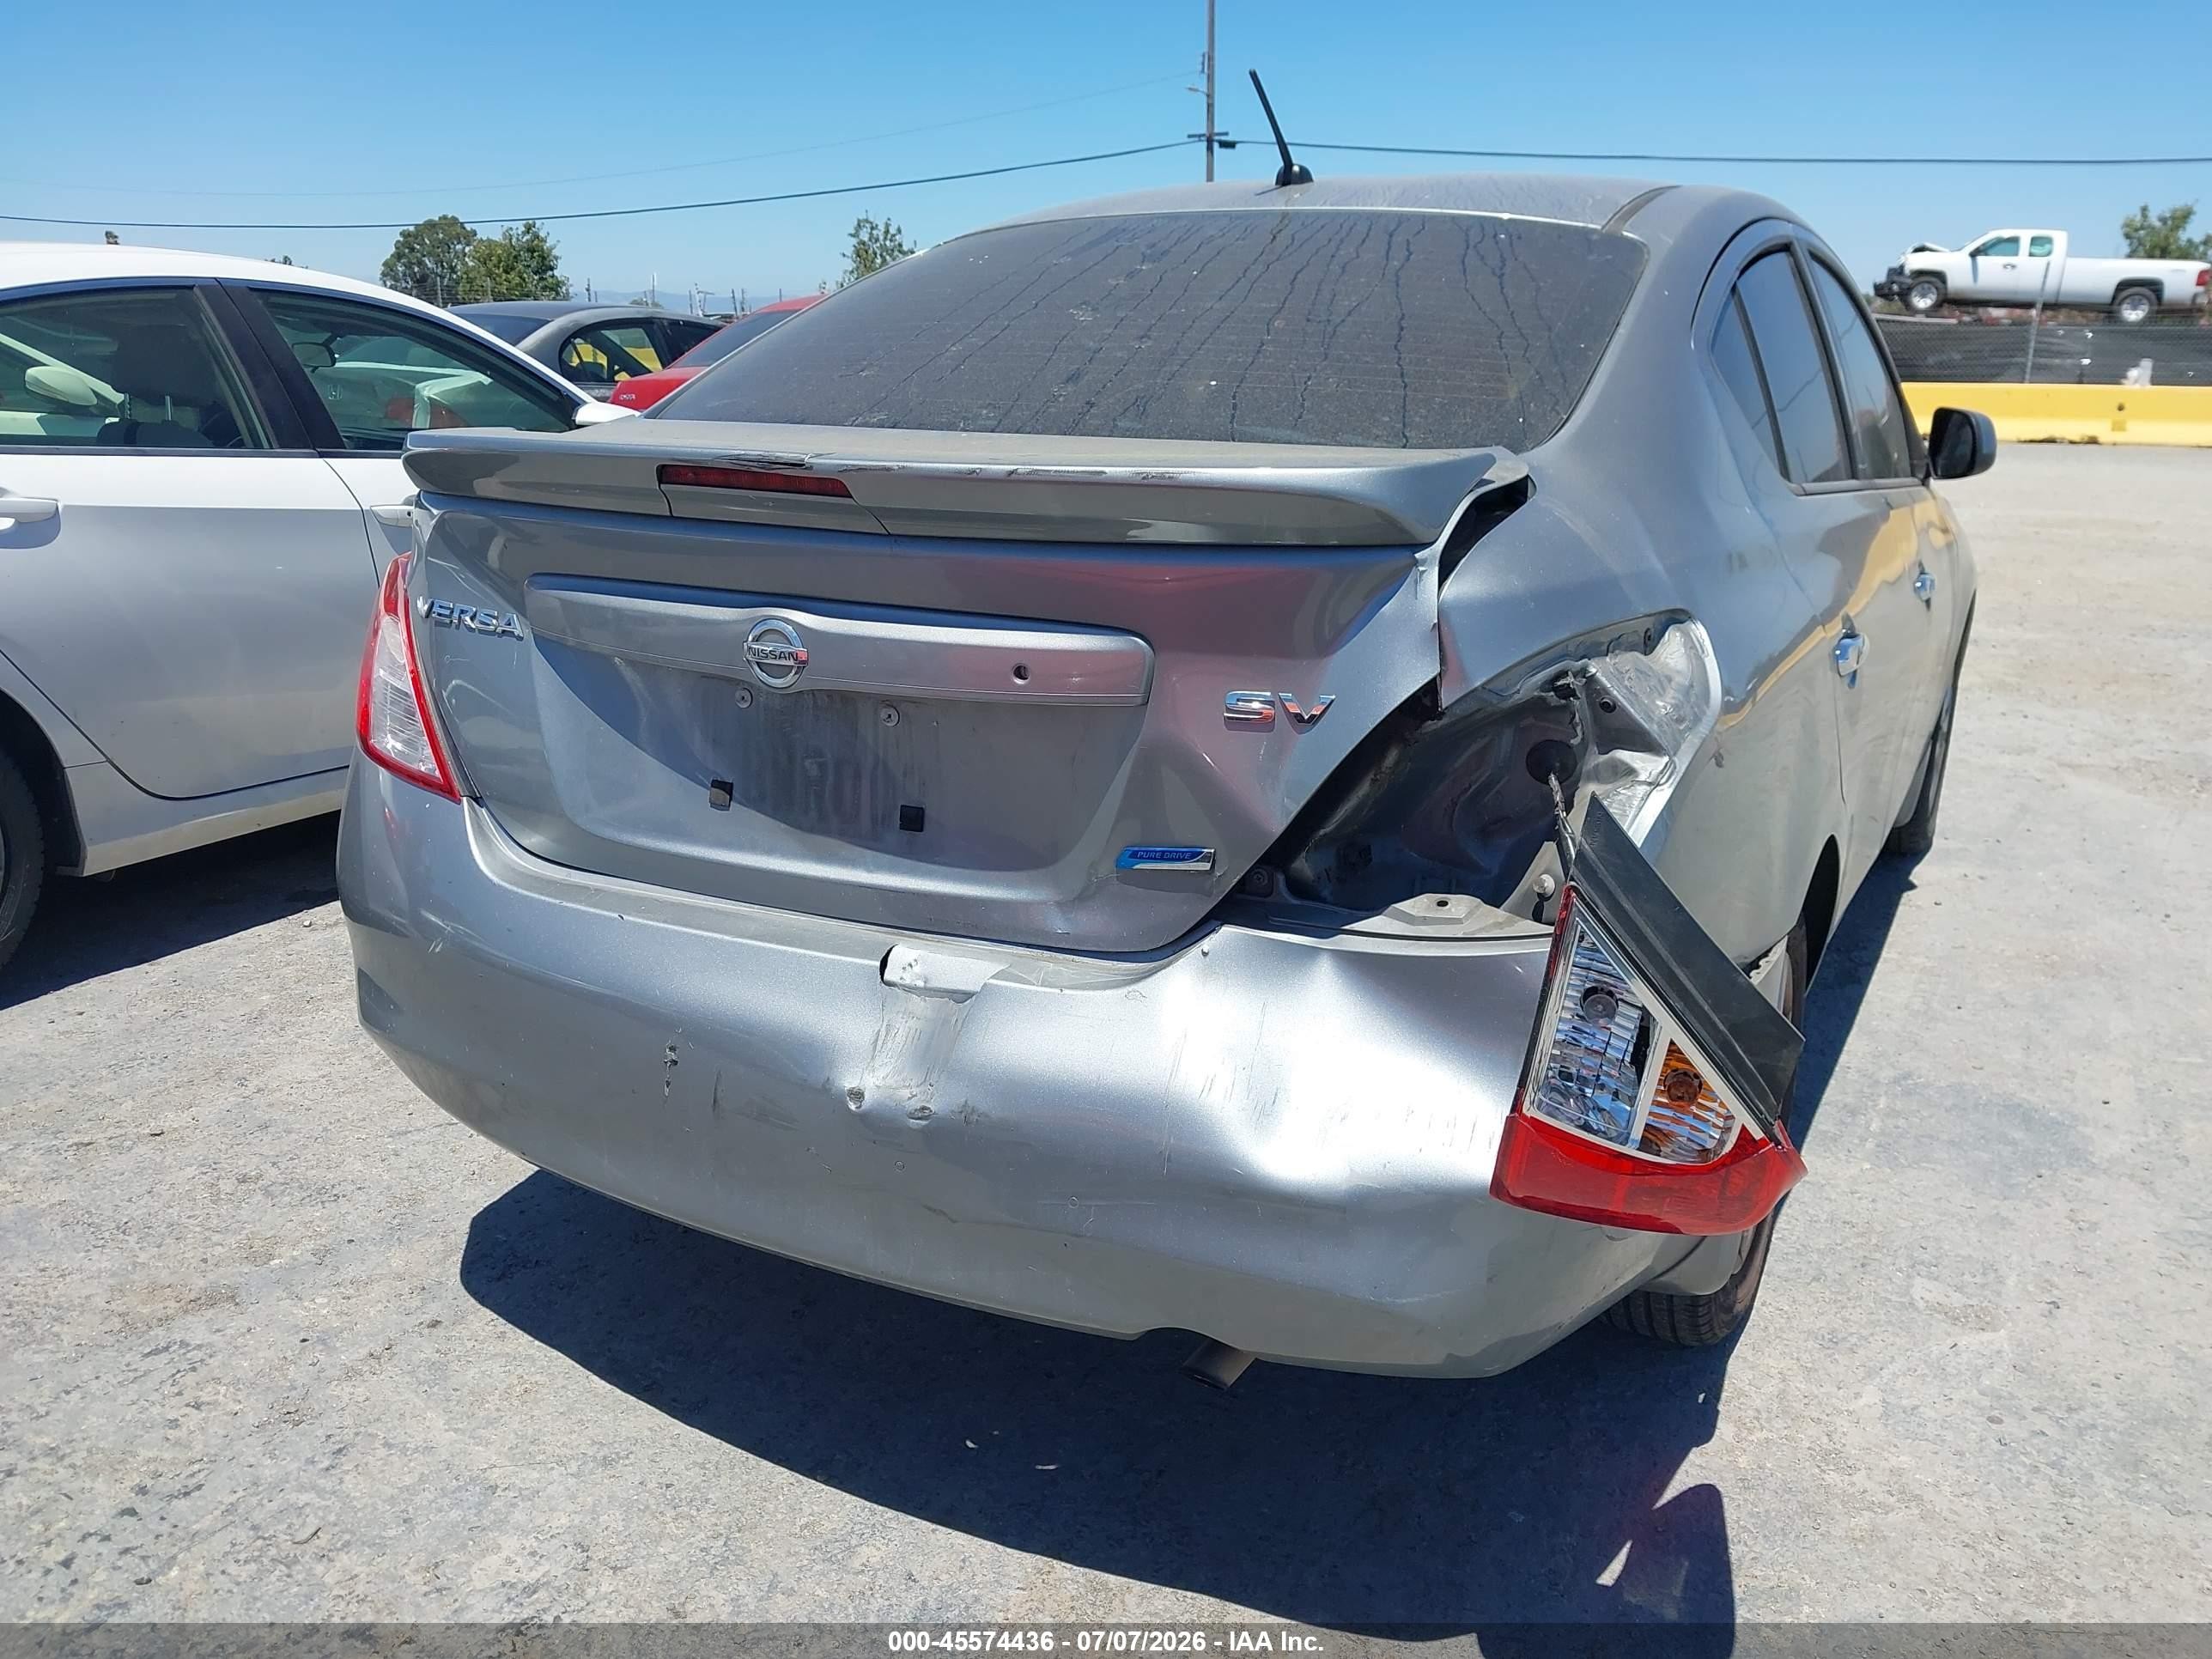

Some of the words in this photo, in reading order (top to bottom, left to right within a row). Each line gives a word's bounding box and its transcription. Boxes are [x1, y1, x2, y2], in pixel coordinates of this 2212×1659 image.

[416, 596, 523, 640] VERSA
[748, 647, 799, 662] NISSAN
[1224, 690, 1336, 726] SV
[1137, 851, 1162, 860] PURE
